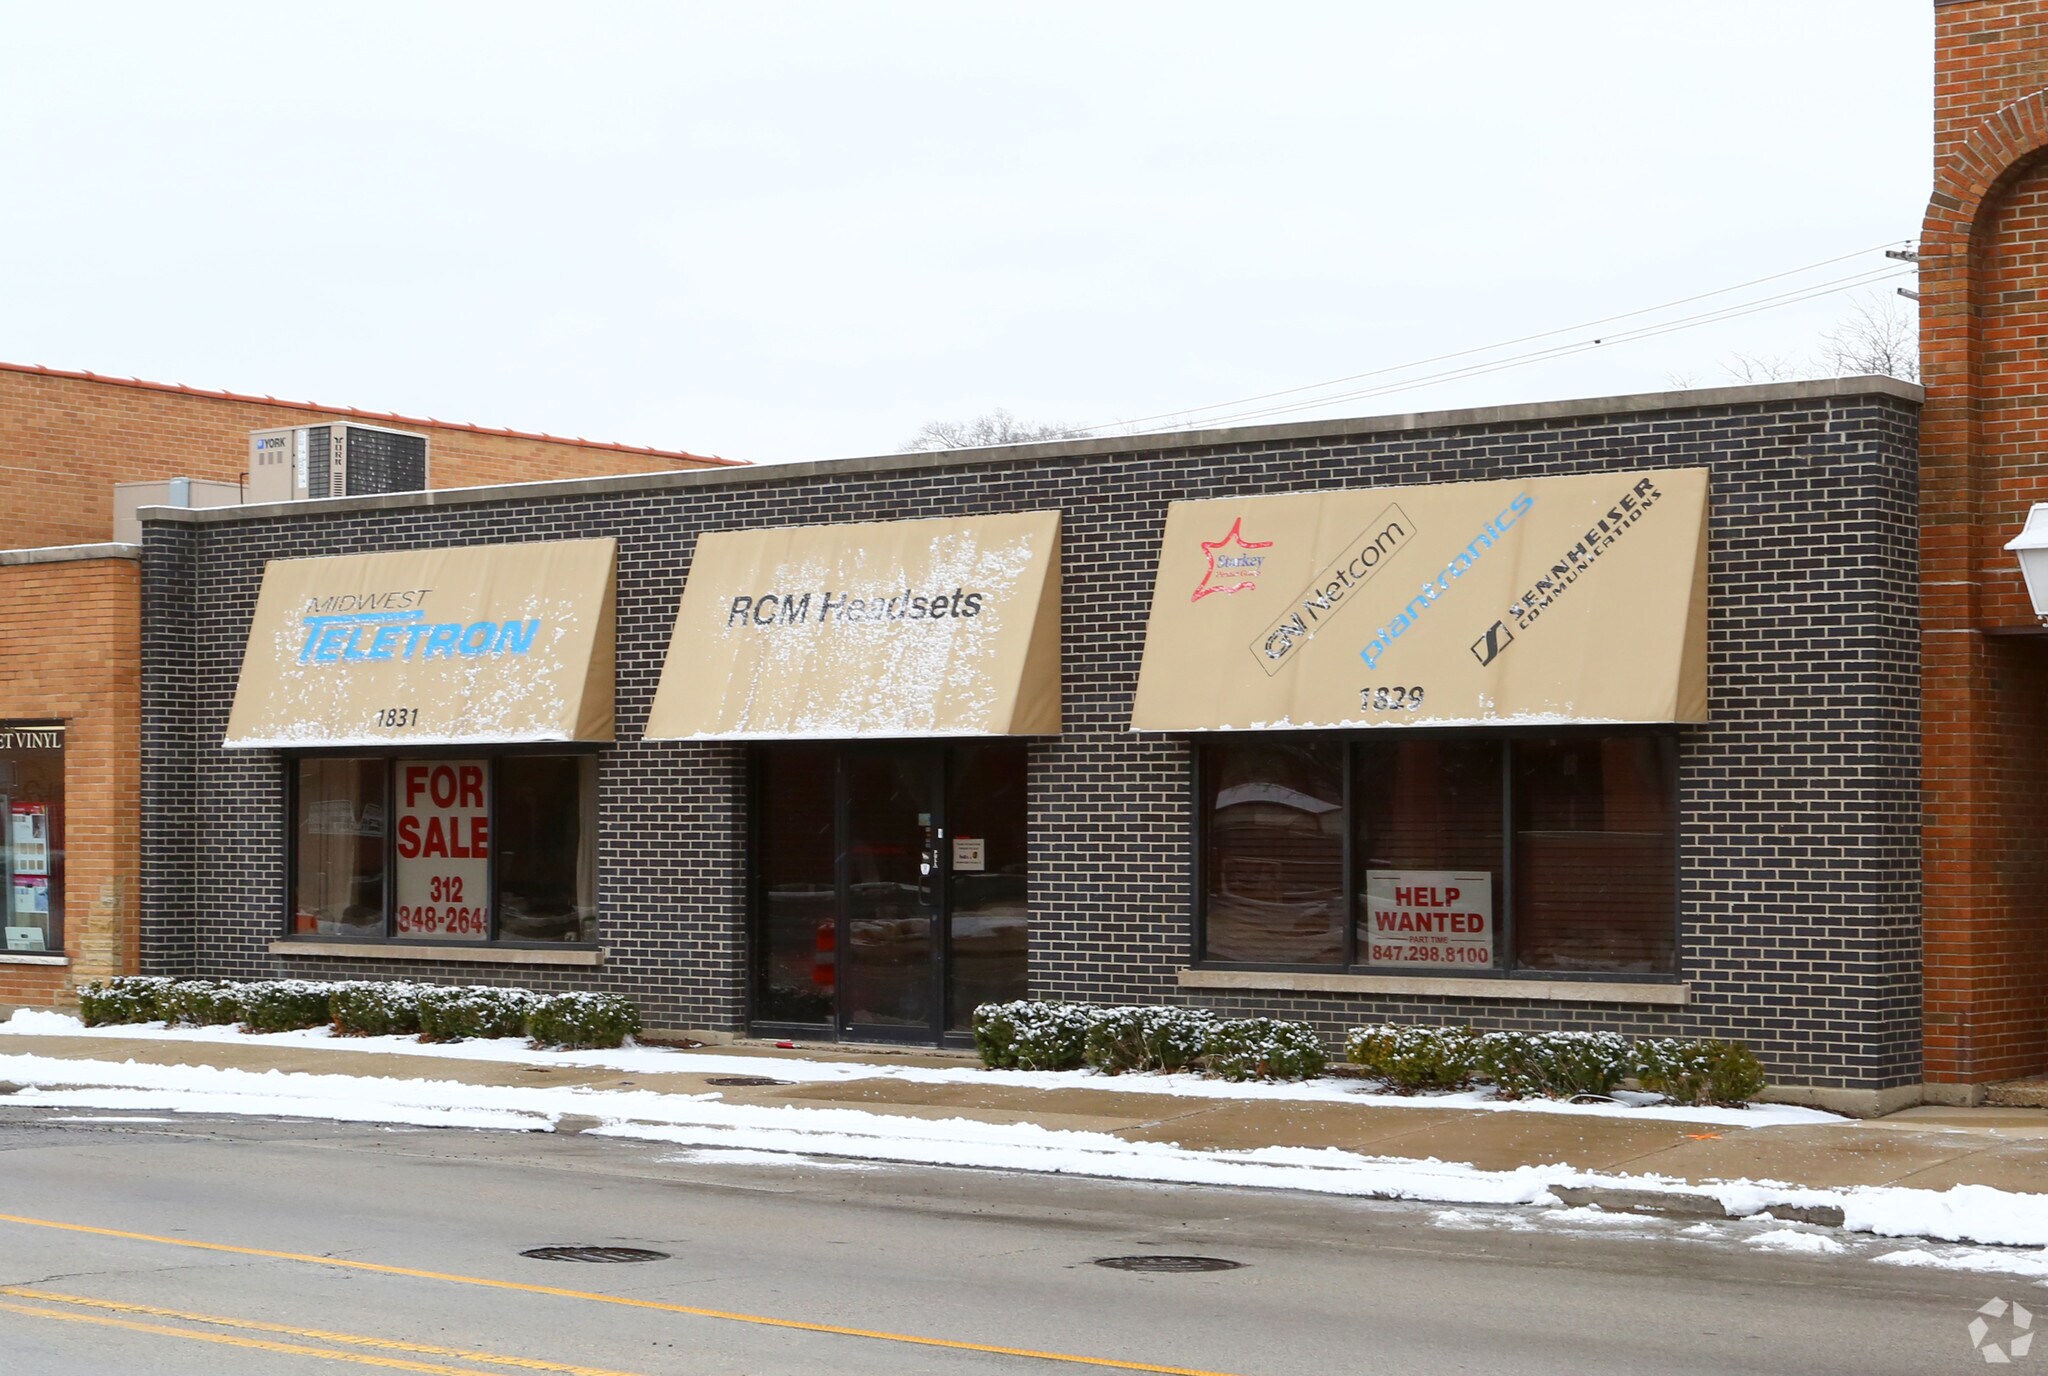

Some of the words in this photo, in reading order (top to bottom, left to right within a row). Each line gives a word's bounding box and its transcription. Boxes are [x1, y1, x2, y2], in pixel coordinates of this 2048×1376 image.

[265, 437, 286, 449] YORK
[334, 437, 343, 465] YORK
[1509, 477, 1654, 621] SENNHEISER
[1518, 489, 1662, 630] COMMUNICATIONS
[1303, 522, 1405, 622] Netcom
[1360, 491, 1534, 670] plantronics
[307, 589, 432, 613] MIDWEST
[727, 592, 811, 627] RCM
[818, 588, 983, 623] Headsets
[298, 610, 541, 665] TELETRON
[1360, 685, 1425, 712] 1829
[377, 708, 419, 727] 1831
[14, 732, 62, 749] VINYL
[406, 765, 484, 808] FOR
[397, 815, 488, 859] SALE
[430, 876, 463, 903] 312
[1395, 886, 1461, 907] HELP
[1374, 911, 1485, 933] WANTED
[1408, 936, 1429, 944] PART
[1431, 936, 1448, 944] TIME
[1372, 945, 1489, 963] 847.298.8100
